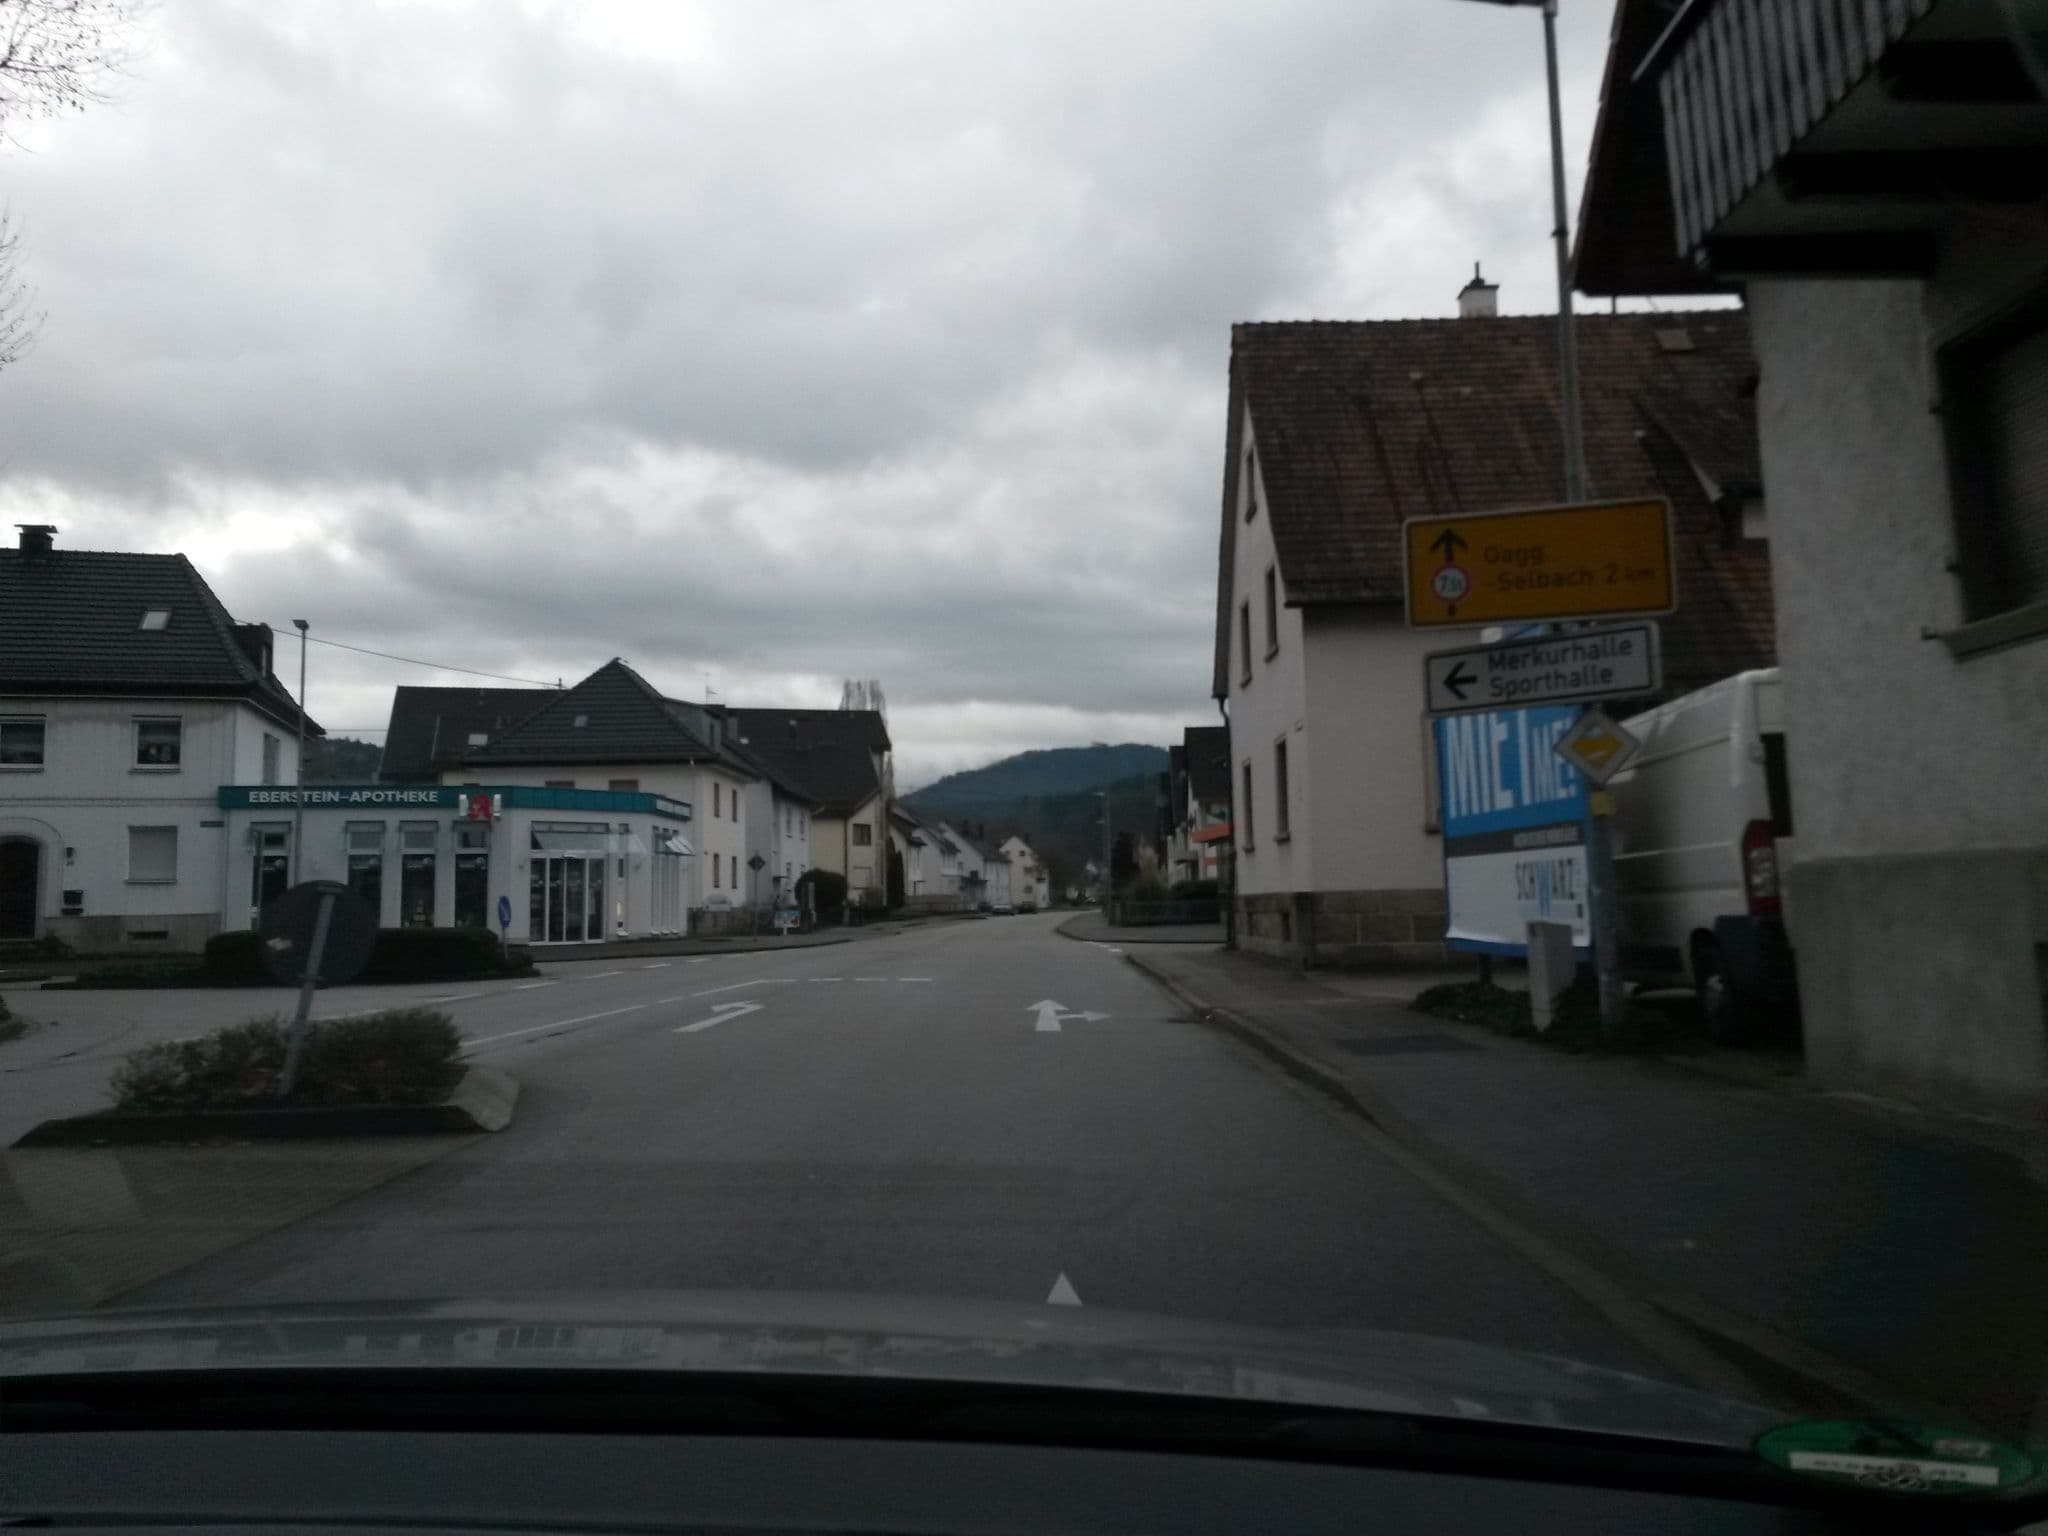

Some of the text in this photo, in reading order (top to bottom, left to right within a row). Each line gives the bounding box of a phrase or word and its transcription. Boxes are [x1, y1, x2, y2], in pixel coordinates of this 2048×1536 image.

[1604, 561, 1618, 585] 2
[1624, 564, 1656, 584] km
[1487, 637, 1632, 671] Merkurhalle
[1489, 664, 1614, 698] Sporthalle
[248, 790, 439, 804] EBERSTEIN-APOTHEKE
